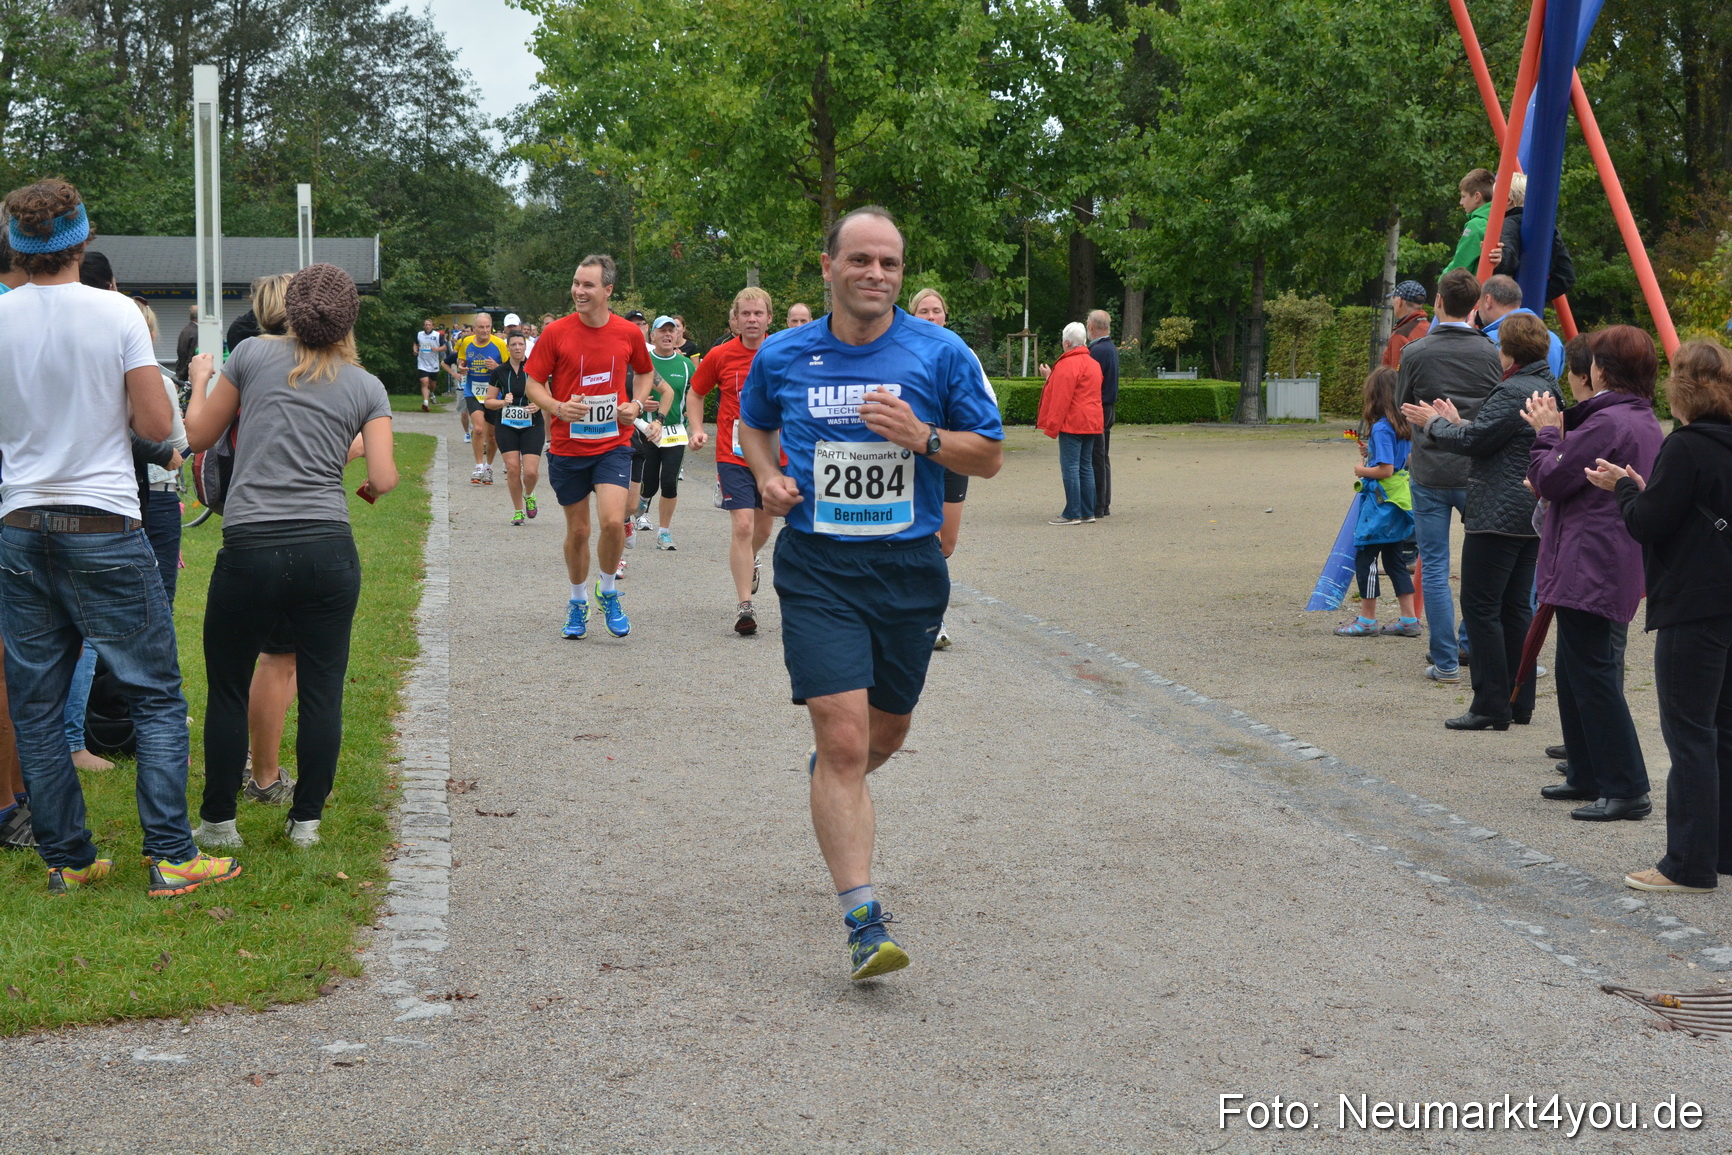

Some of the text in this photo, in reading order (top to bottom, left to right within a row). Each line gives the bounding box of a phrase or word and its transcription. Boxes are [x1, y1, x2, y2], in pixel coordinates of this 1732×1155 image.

[580, 404, 614, 422] 102
[583, 426, 606, 434] Philipp
[817, 449, 897, 461] PARTL Neumarkt
[824, 463, 905, 500] 2884
[834, 507, 893, 522] Bernhard
